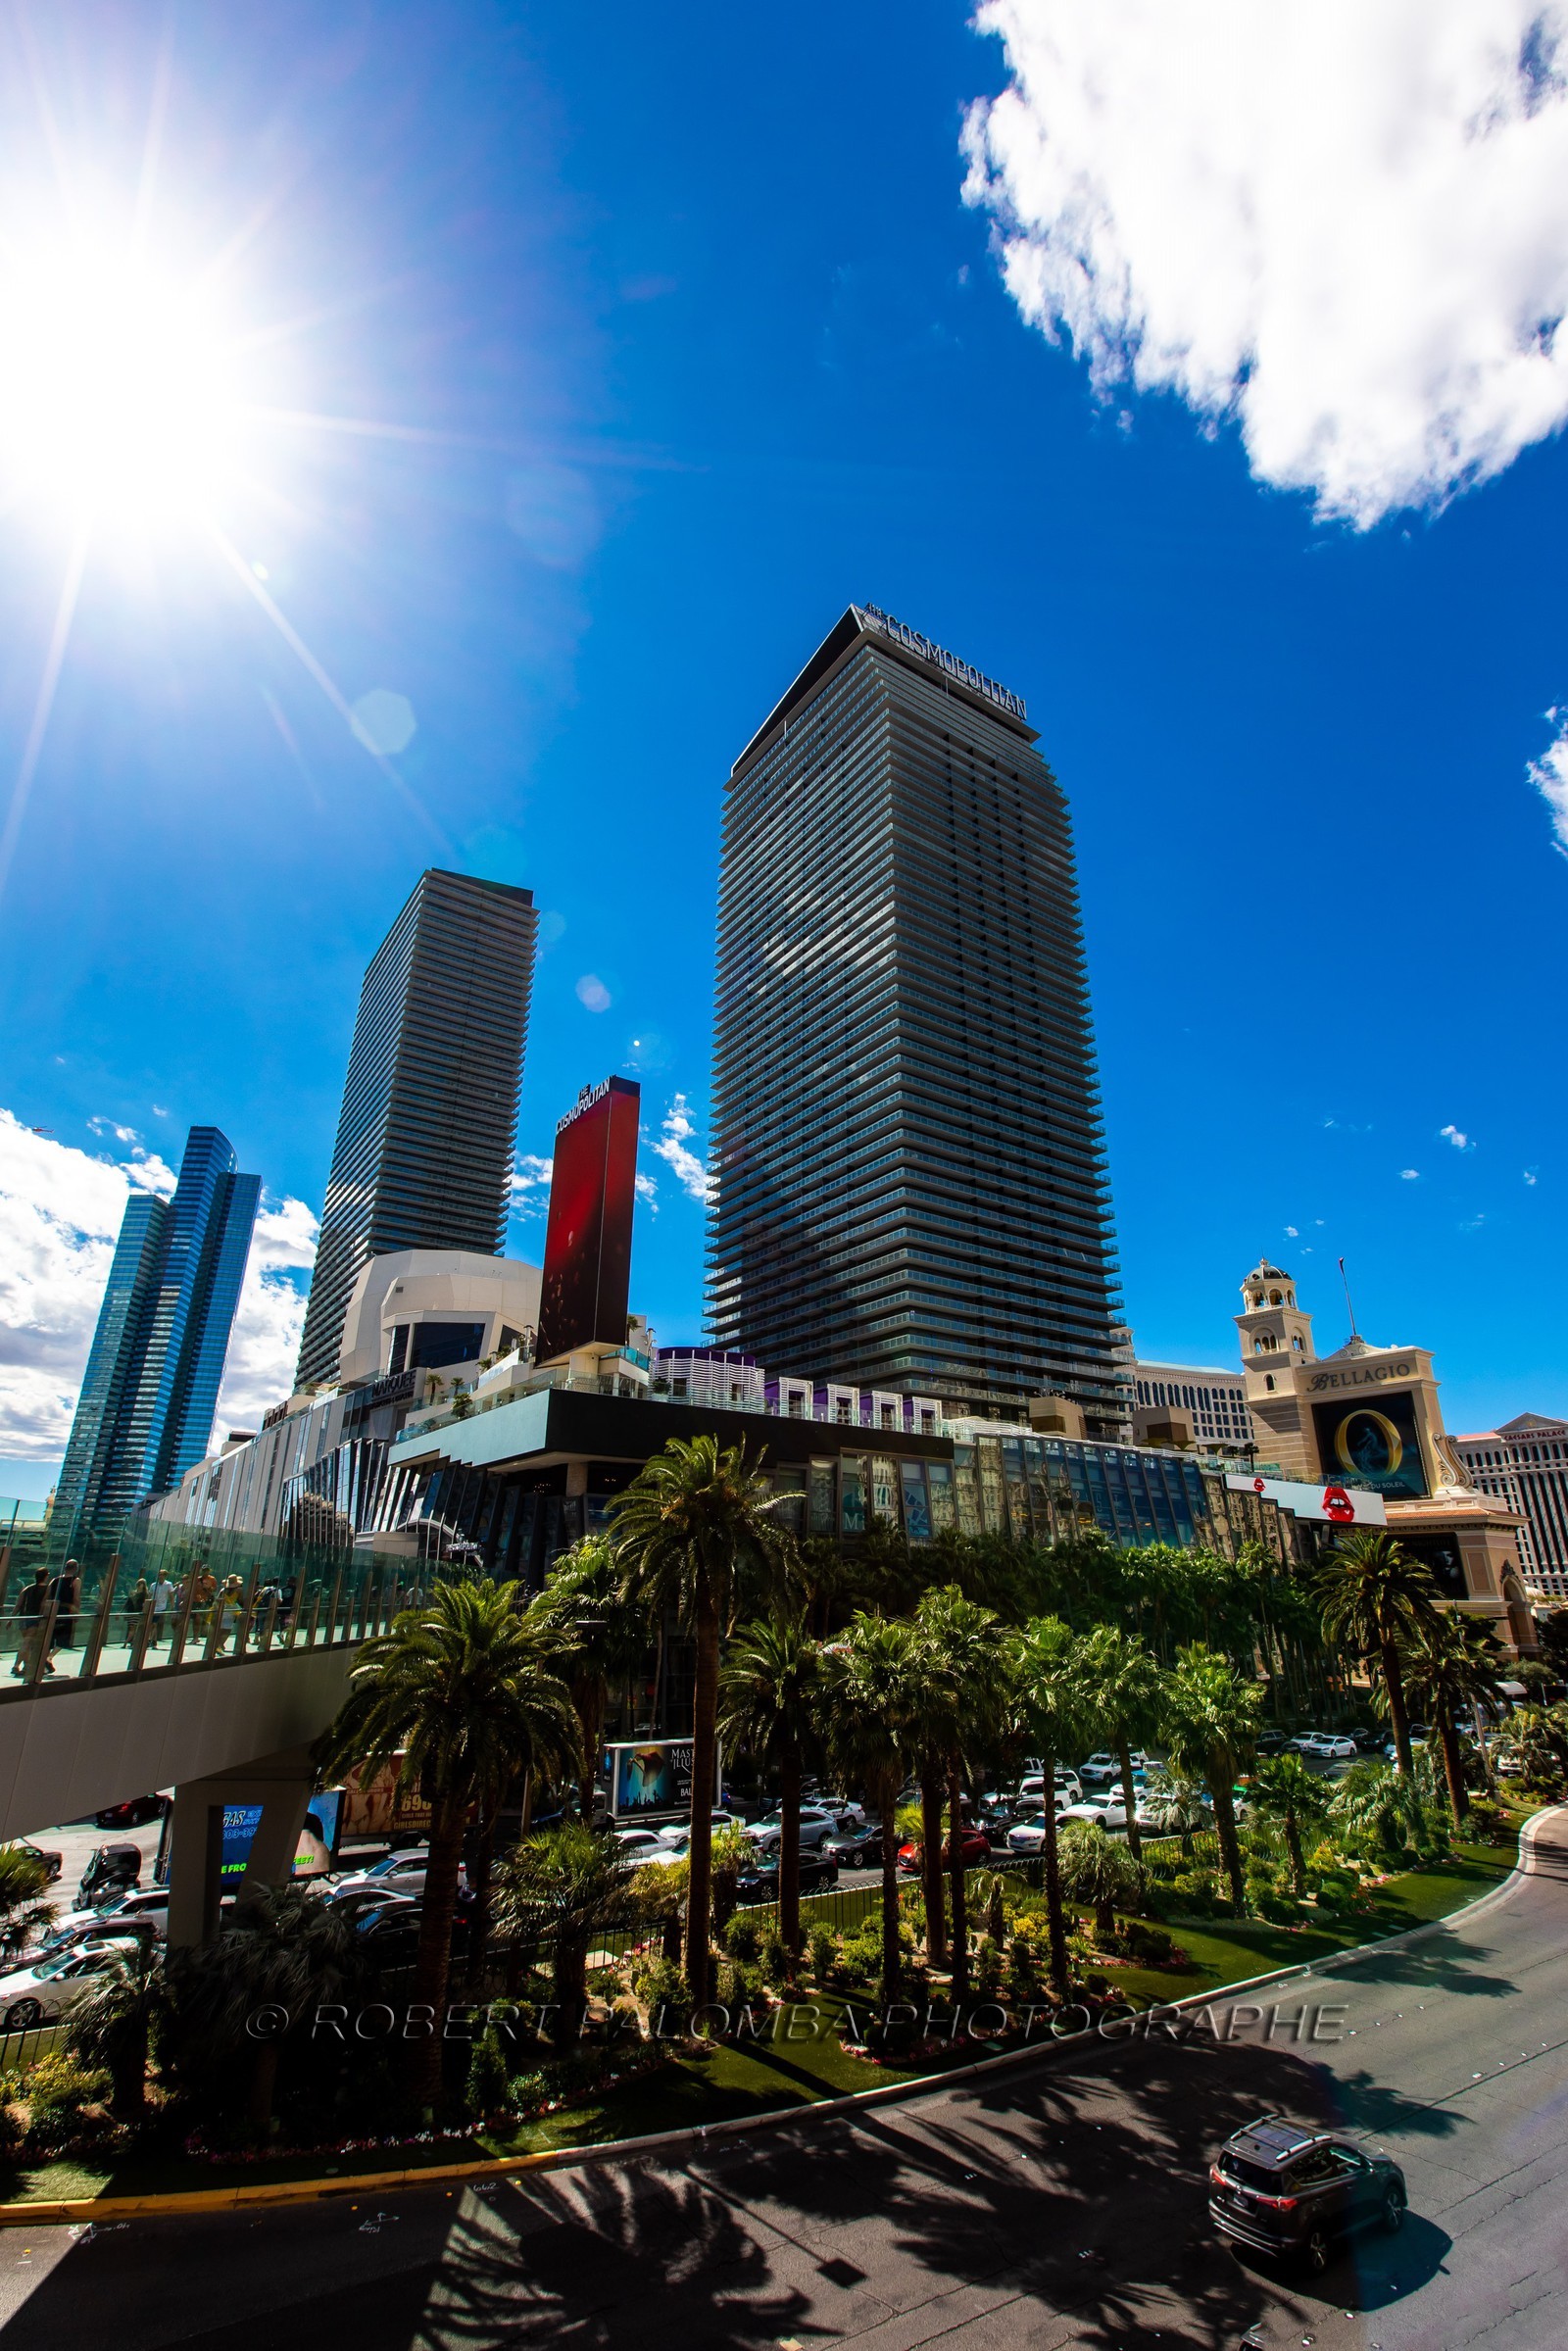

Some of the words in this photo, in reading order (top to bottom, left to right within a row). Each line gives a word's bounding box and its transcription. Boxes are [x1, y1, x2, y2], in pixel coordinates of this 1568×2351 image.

[886, 614, 1027, 720] COSMOPOLITAN
[556, 1077, 610, 1134] COSMOPOLITAN
[1306, 1363, 1410, 1393] BELLAGIO
[1335, 1409, 1402, 1479] O
[1537, 1429, 1566, 1439] PALACE
